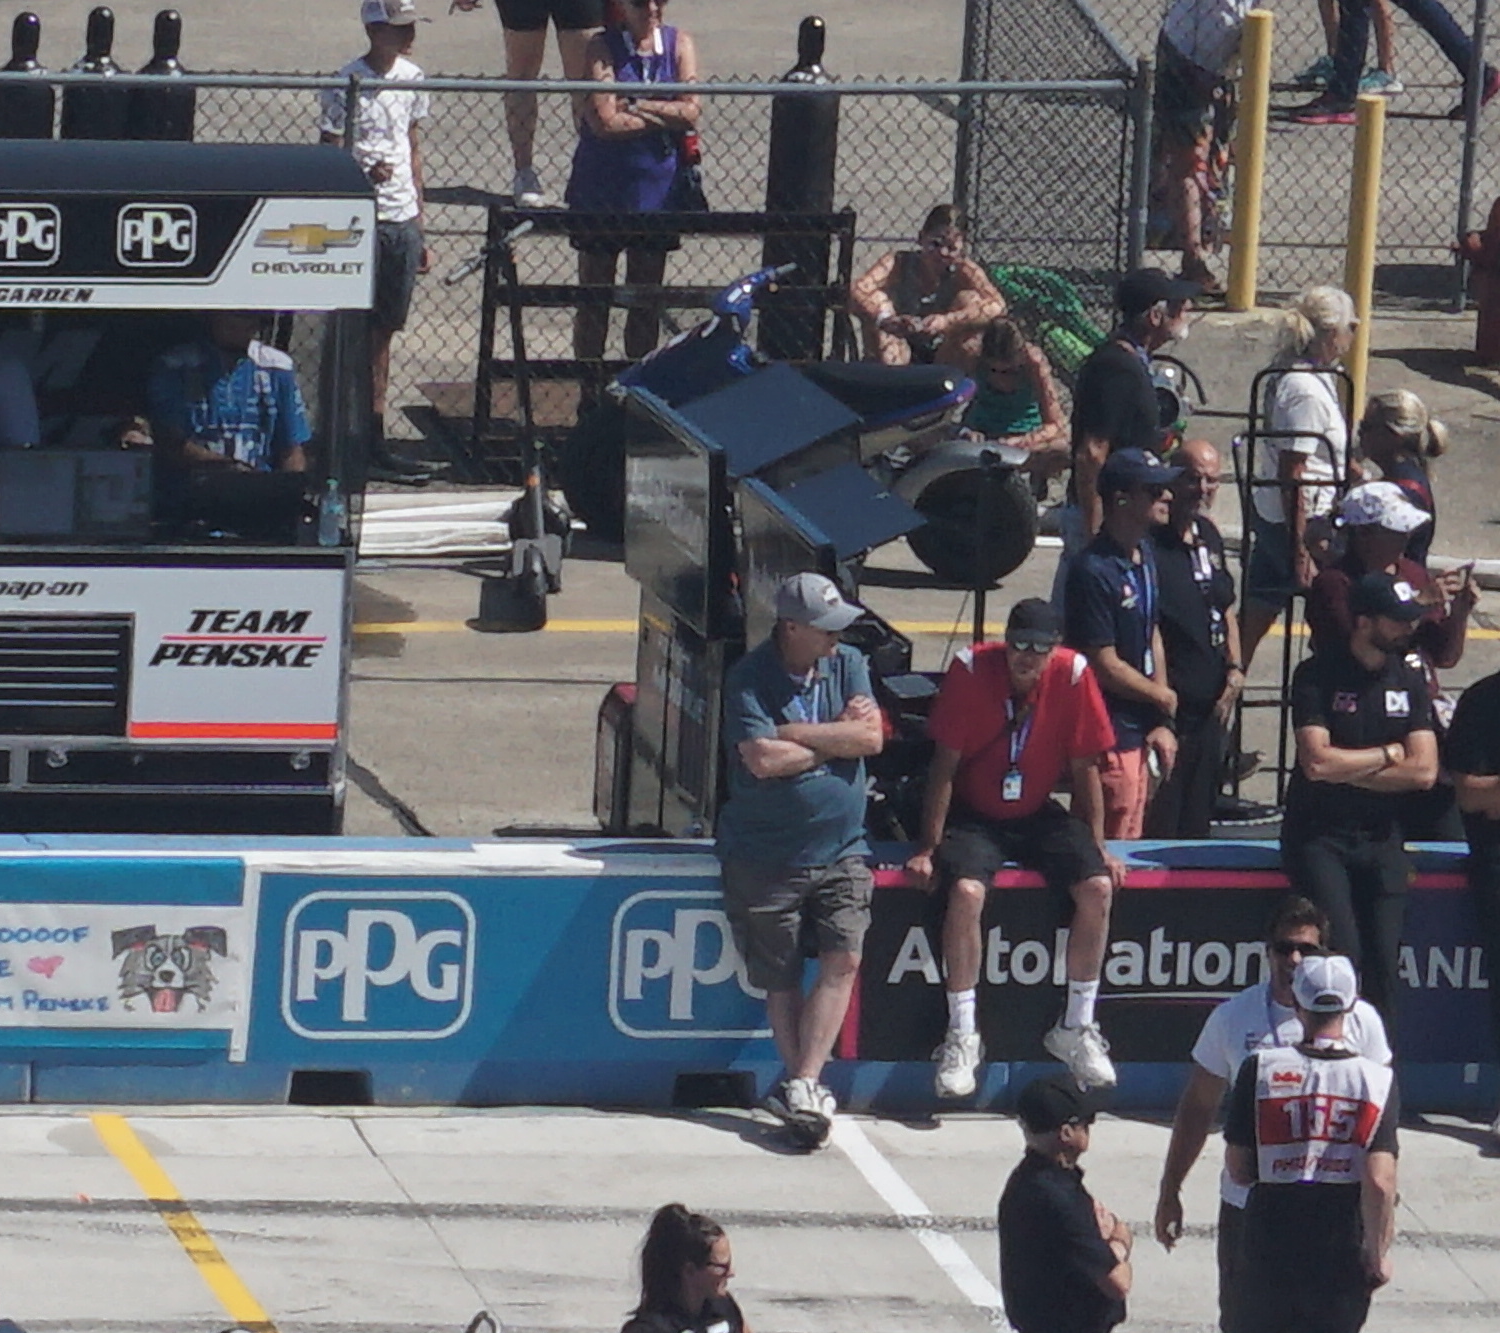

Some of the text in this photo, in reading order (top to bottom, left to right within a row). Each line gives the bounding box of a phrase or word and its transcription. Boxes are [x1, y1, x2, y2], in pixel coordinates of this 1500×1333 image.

[122, 209, 193, 260] PPG
[252, 262, 364, 275] CHEVROLET
[185, 610, 312, 633] TEAM
[149, 643, 322, 668] PENSKE
[296, 908, 463, 1022] PPG
